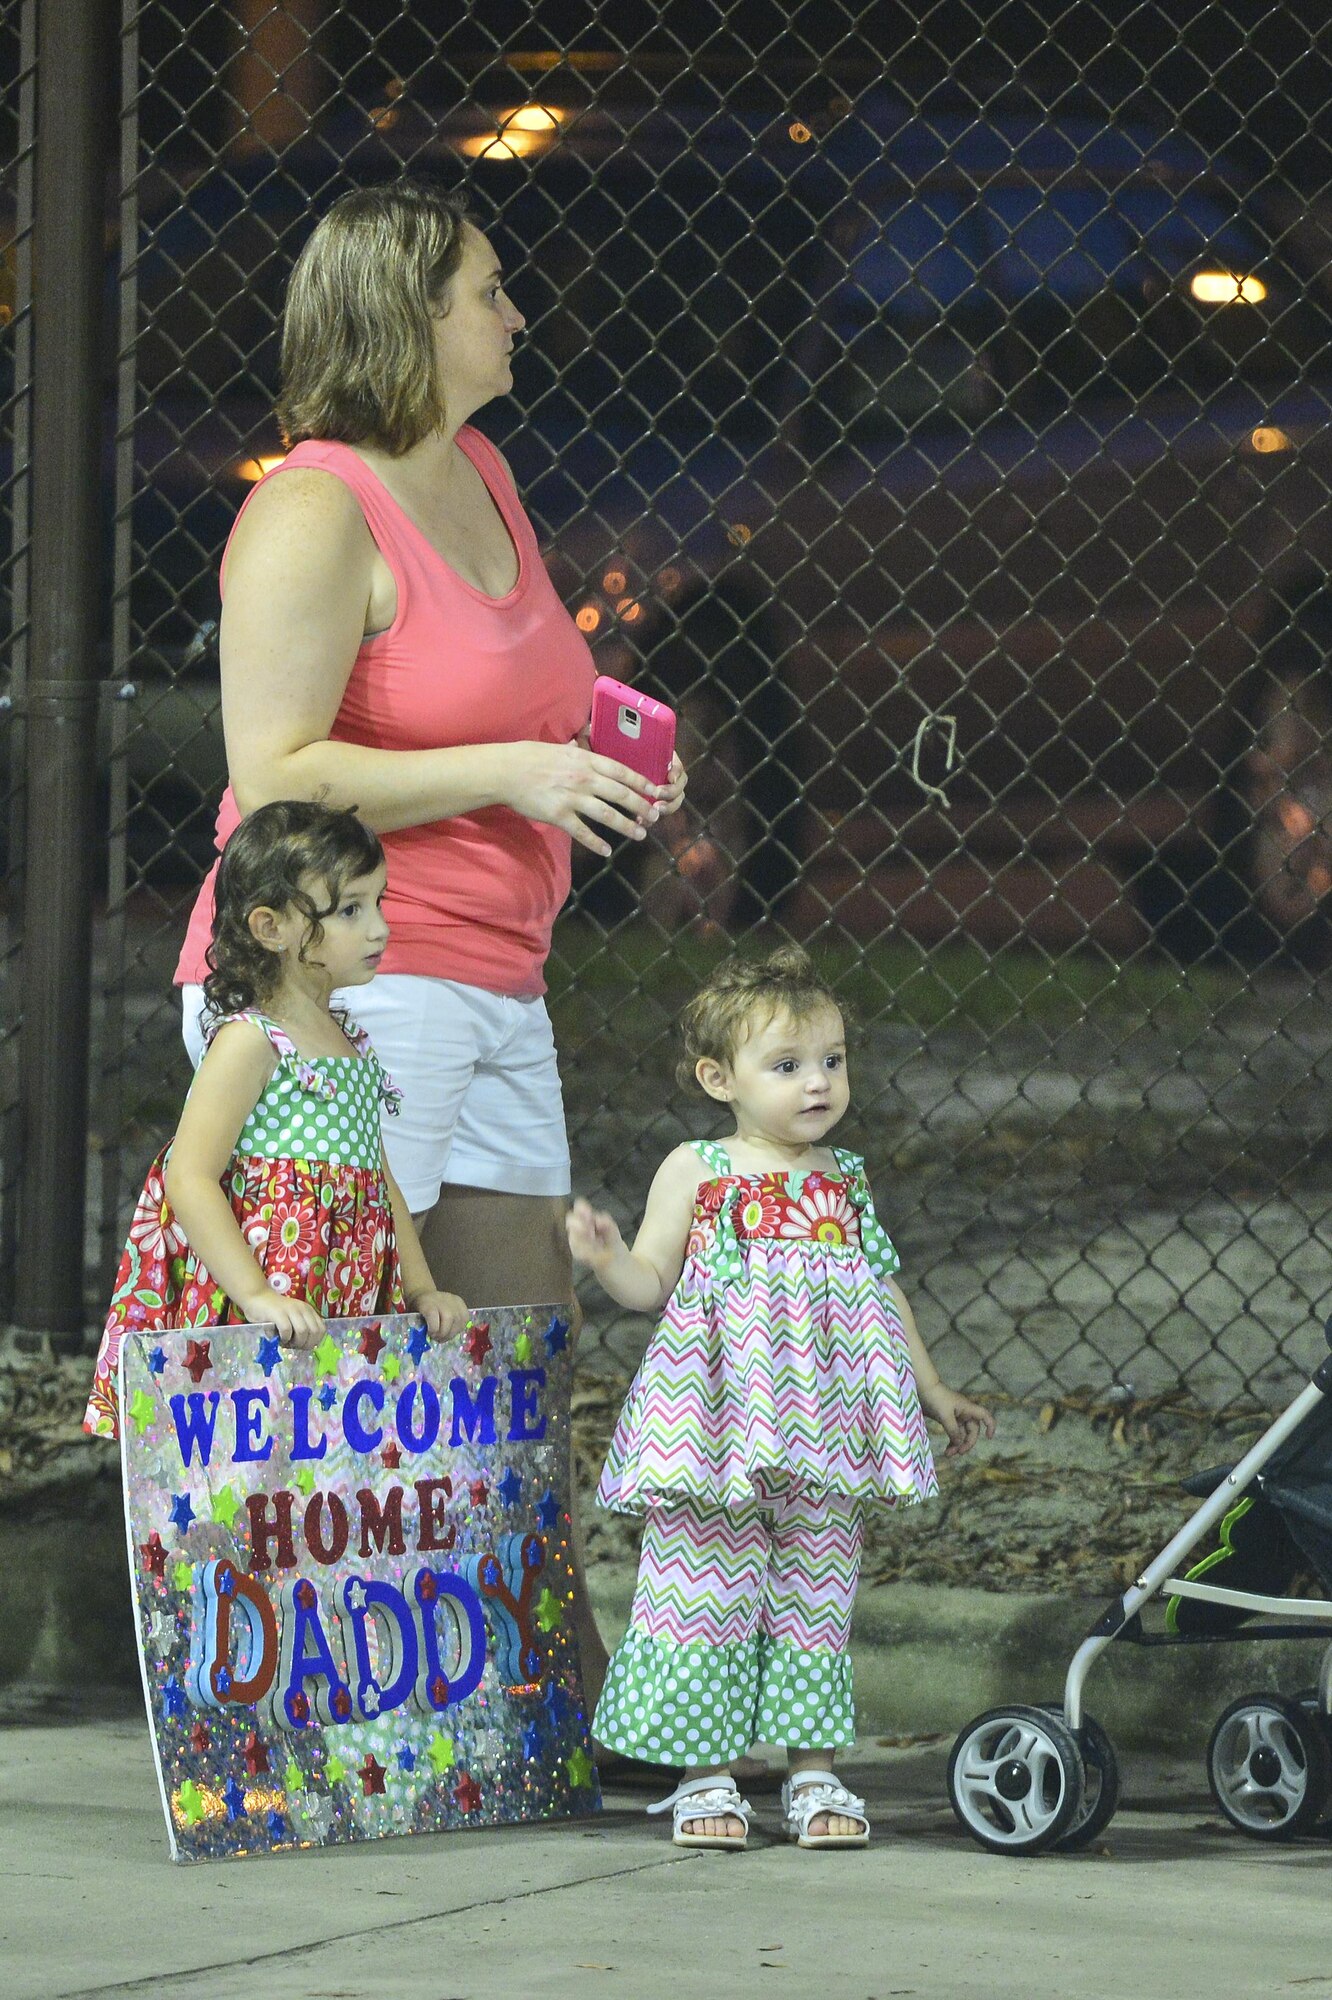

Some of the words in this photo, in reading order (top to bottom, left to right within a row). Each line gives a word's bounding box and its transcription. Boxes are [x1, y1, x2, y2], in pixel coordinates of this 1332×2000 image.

[169, 1367, 548, 1468] WELCOME
[245, 1475, 457, 1571] HOME
[188, 1533, 547, 1731] DADDY
